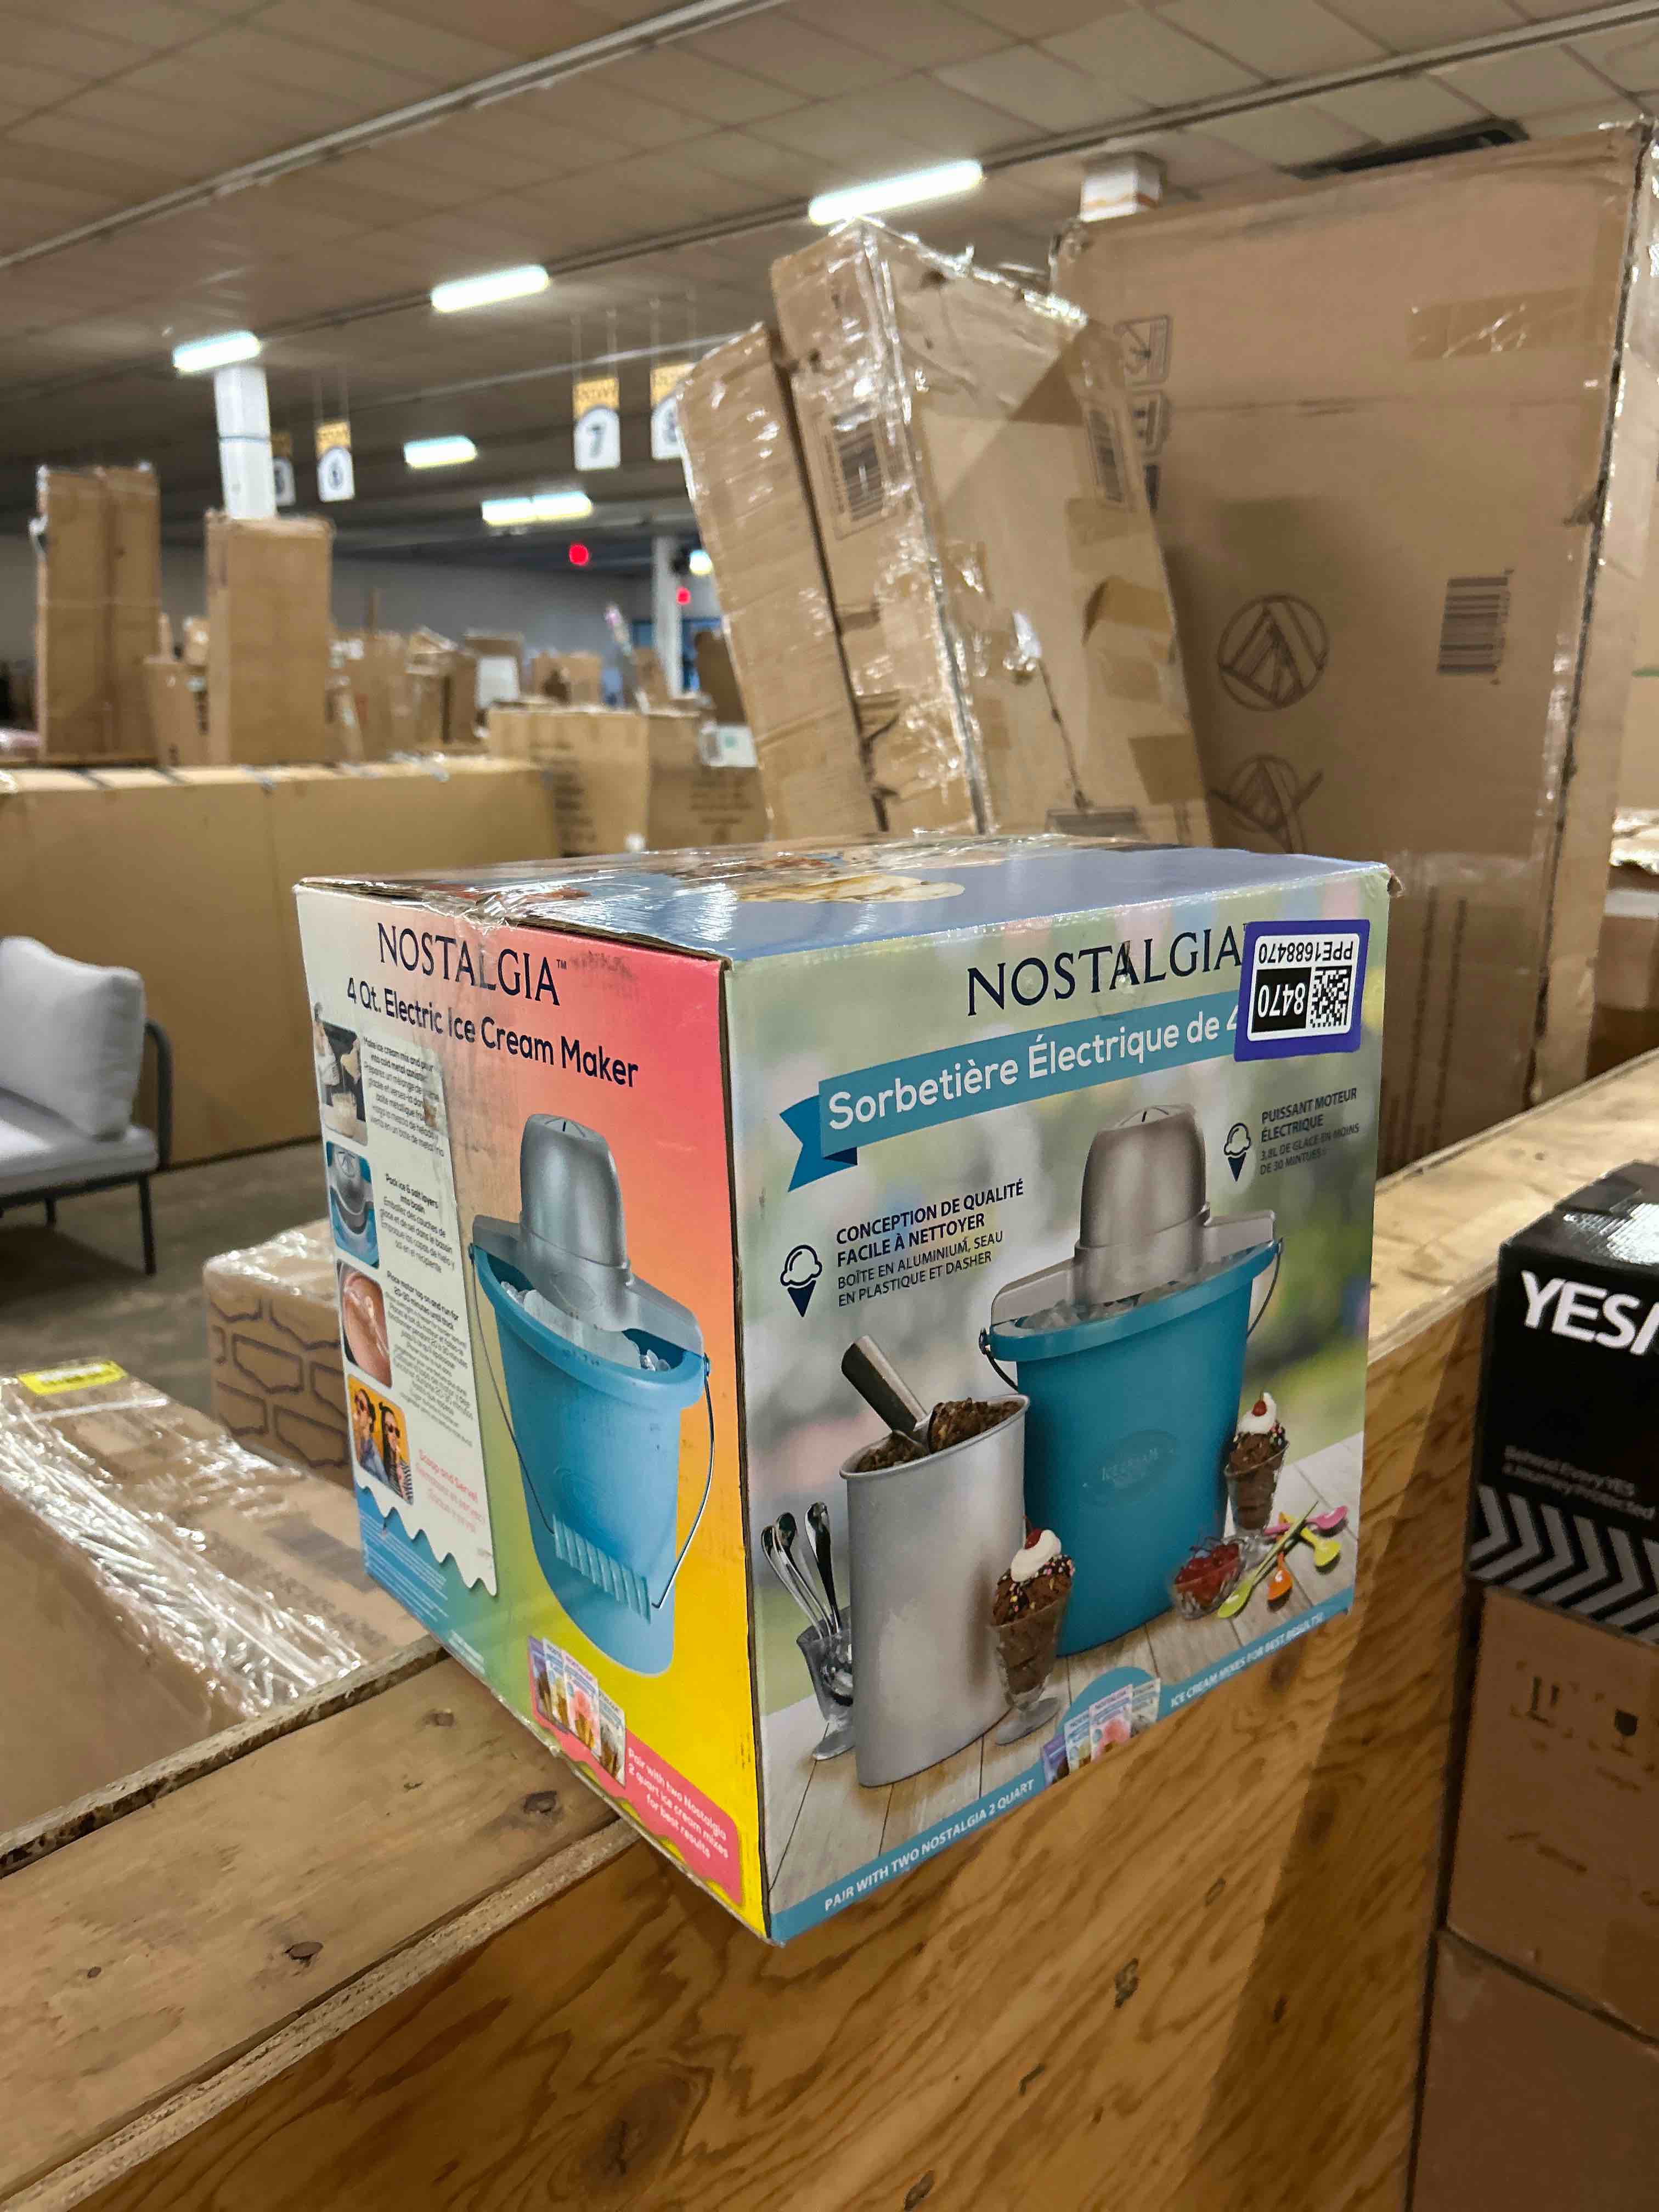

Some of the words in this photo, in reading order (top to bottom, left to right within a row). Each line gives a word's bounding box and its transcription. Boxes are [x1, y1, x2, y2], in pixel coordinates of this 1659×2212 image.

[377, 922, 560, 1006] NOSTALGIA
[967, 925, 1242, 1016] NOSTALGIA
[1259, 941, 1353, 964] PPE1688470
[1257, 983, 1306, 1018] 8470
[347, 977, 357, 1005] 4
[359, 985, 381, 1014] Qt.
[385, 988, 443, 1035] Electric
[448, 1007, 476, 1043] Ice
[481, 1017, 554, 1065] Cream
[561, 1036, 639, 1087] Maker
[828, 1058, 1018, 1131] Sorbetière
[1029, 1022, 1178, 1080] Électrique
[1187, 1011, 1219, 1045] de
[1261, 1114, 1324, 1143] ÉLECTRIQUE
[1262, 1099, 1314, 1124] PUISSANT
[1315, 1087, 1357, 1110] MOTEUR
[1260, 1163, 1272, 1176] DE
[1273, 1160, 1284, 1172] 30
[1280, 1143, 1291, 1155] DE
[837, 1204, 936, 1244] CONCEPTION
[941, 1198, 960, 1217] DE
[963, 1178, 1024, 1211] QUALITÉ
[838, 1239, 890, 1267] FACILE
[894, 1233, 905, 1251] À
[909, 1213, 985, 1248] NETTOYER
[838, 1269, 874, 1290] BOÎTE
[878, 1264, 894, 1278] EN
[974, 1230, 1003, 1250] SEAU
[839, 1291, 855, 1308] EN
[859, 1270, 926, 1301] PLASTIQUE
[930, 1265, 941, 1280] ET
[946, 1251, 992, 1274] DASHER
[825, 1886, 854, 1911] PAIR
[856, 1865, 889, 1893] WITH
[891, 1849, 920, 1873] TWO
[921, 1809, 986, 1855] NOSTALGIA
[989, 1803, 996, 1815] 2
[997, 1779, 1035, 1809] QUART
